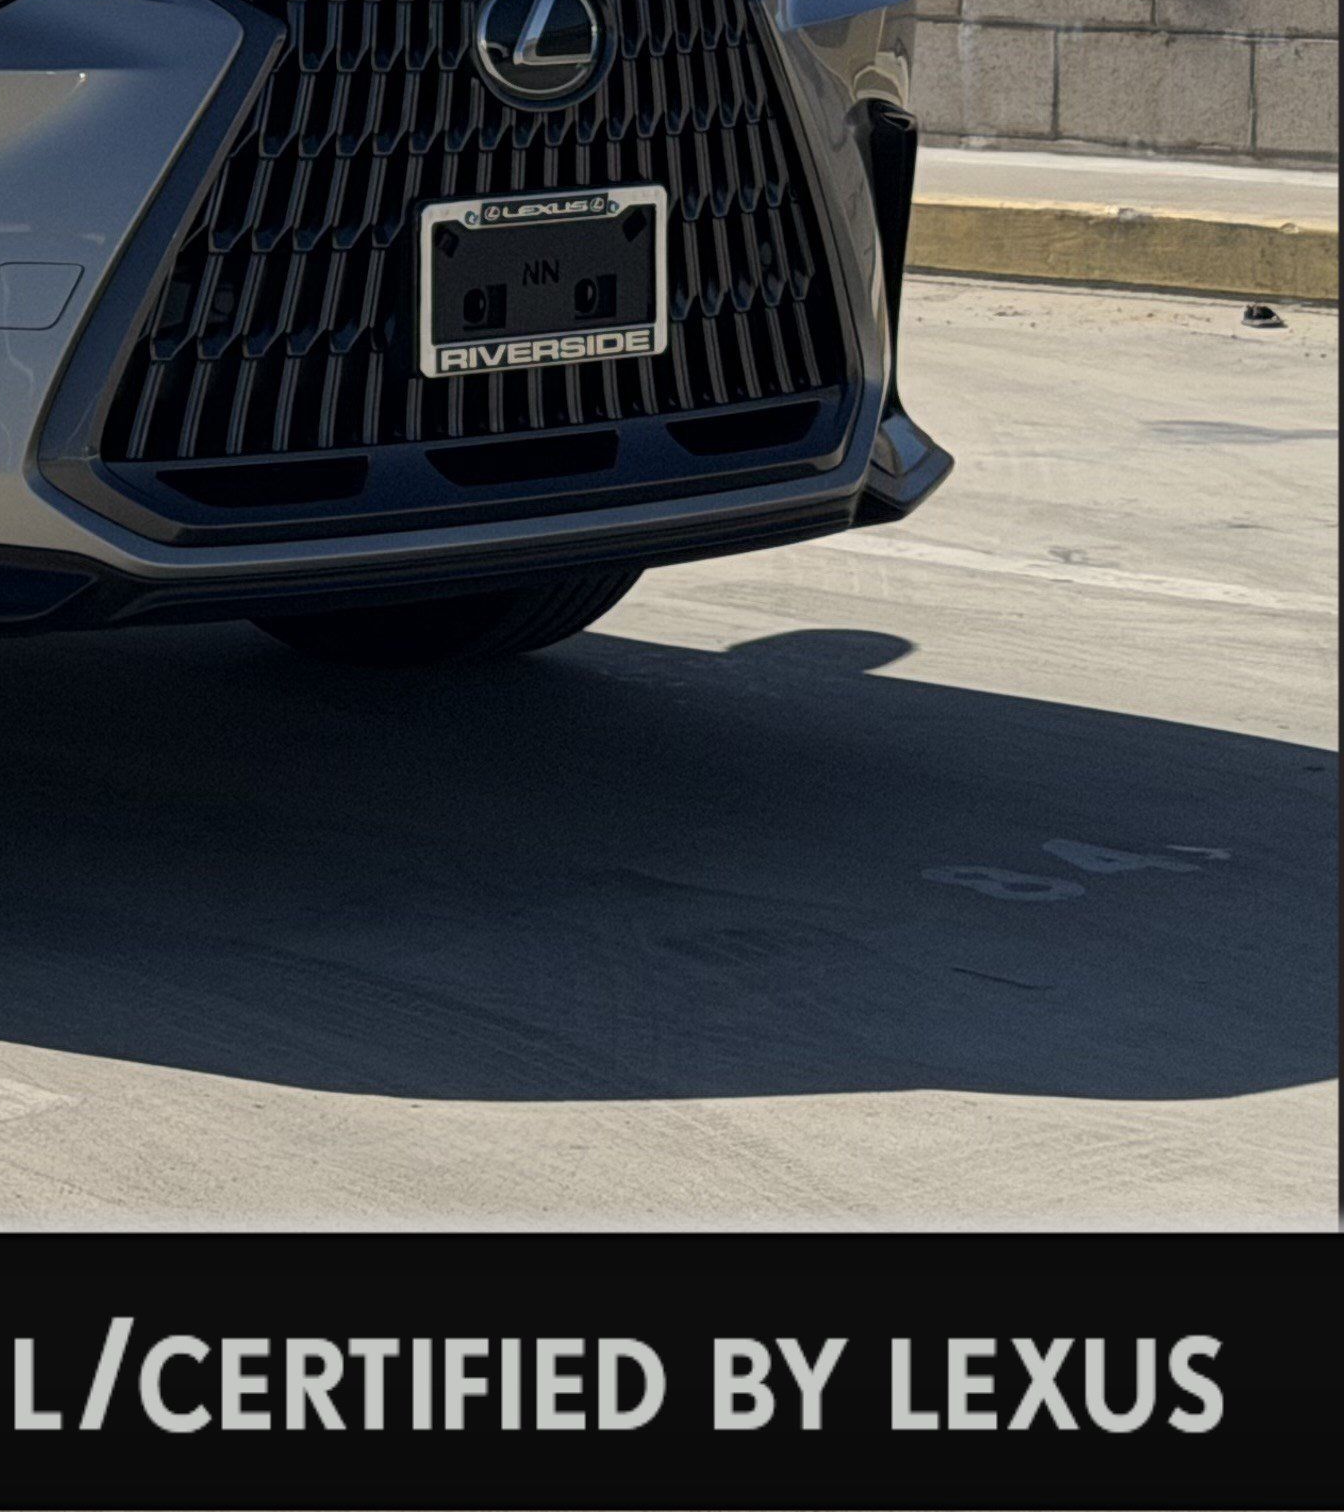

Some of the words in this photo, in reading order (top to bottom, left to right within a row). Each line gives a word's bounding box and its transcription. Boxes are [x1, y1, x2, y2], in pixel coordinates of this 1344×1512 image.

[502, 199, 589, 219] LEXUS
[522, 259, 561, 286] NN
[440, 329, 651, 372] RIVERSIDE
